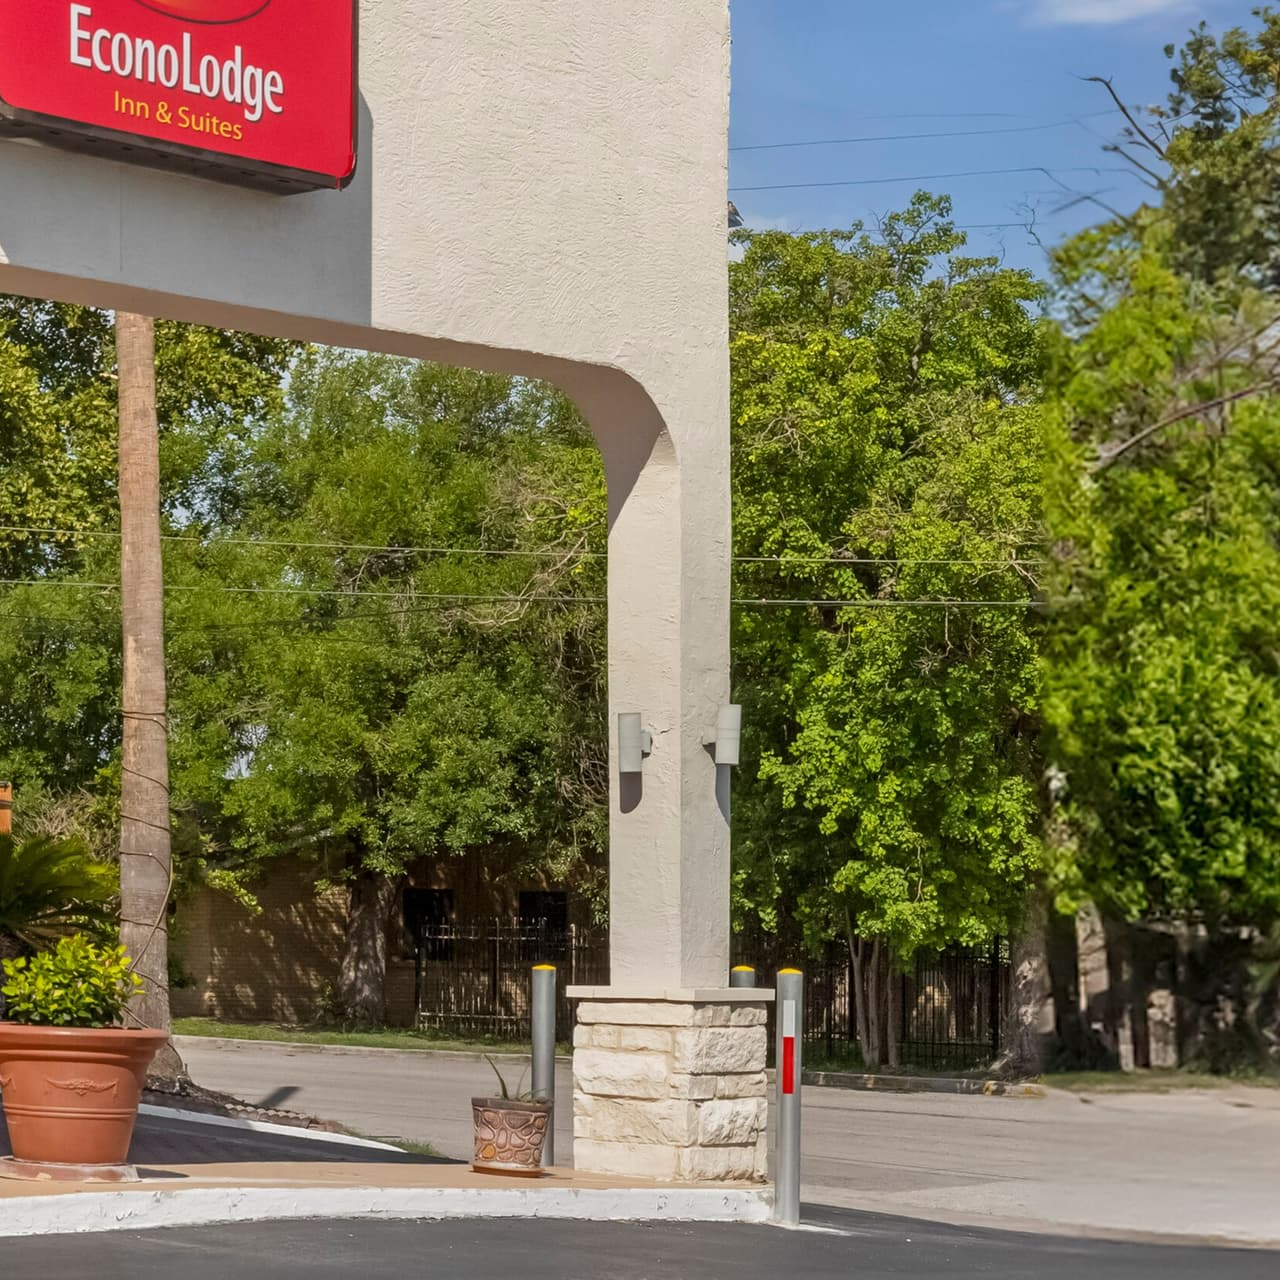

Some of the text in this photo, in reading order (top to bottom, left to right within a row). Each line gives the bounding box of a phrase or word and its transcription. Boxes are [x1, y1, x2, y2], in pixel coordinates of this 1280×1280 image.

[70, 3, 284, 122] EconoLodge
[114, 90, 243, 140] Inn & Suites
